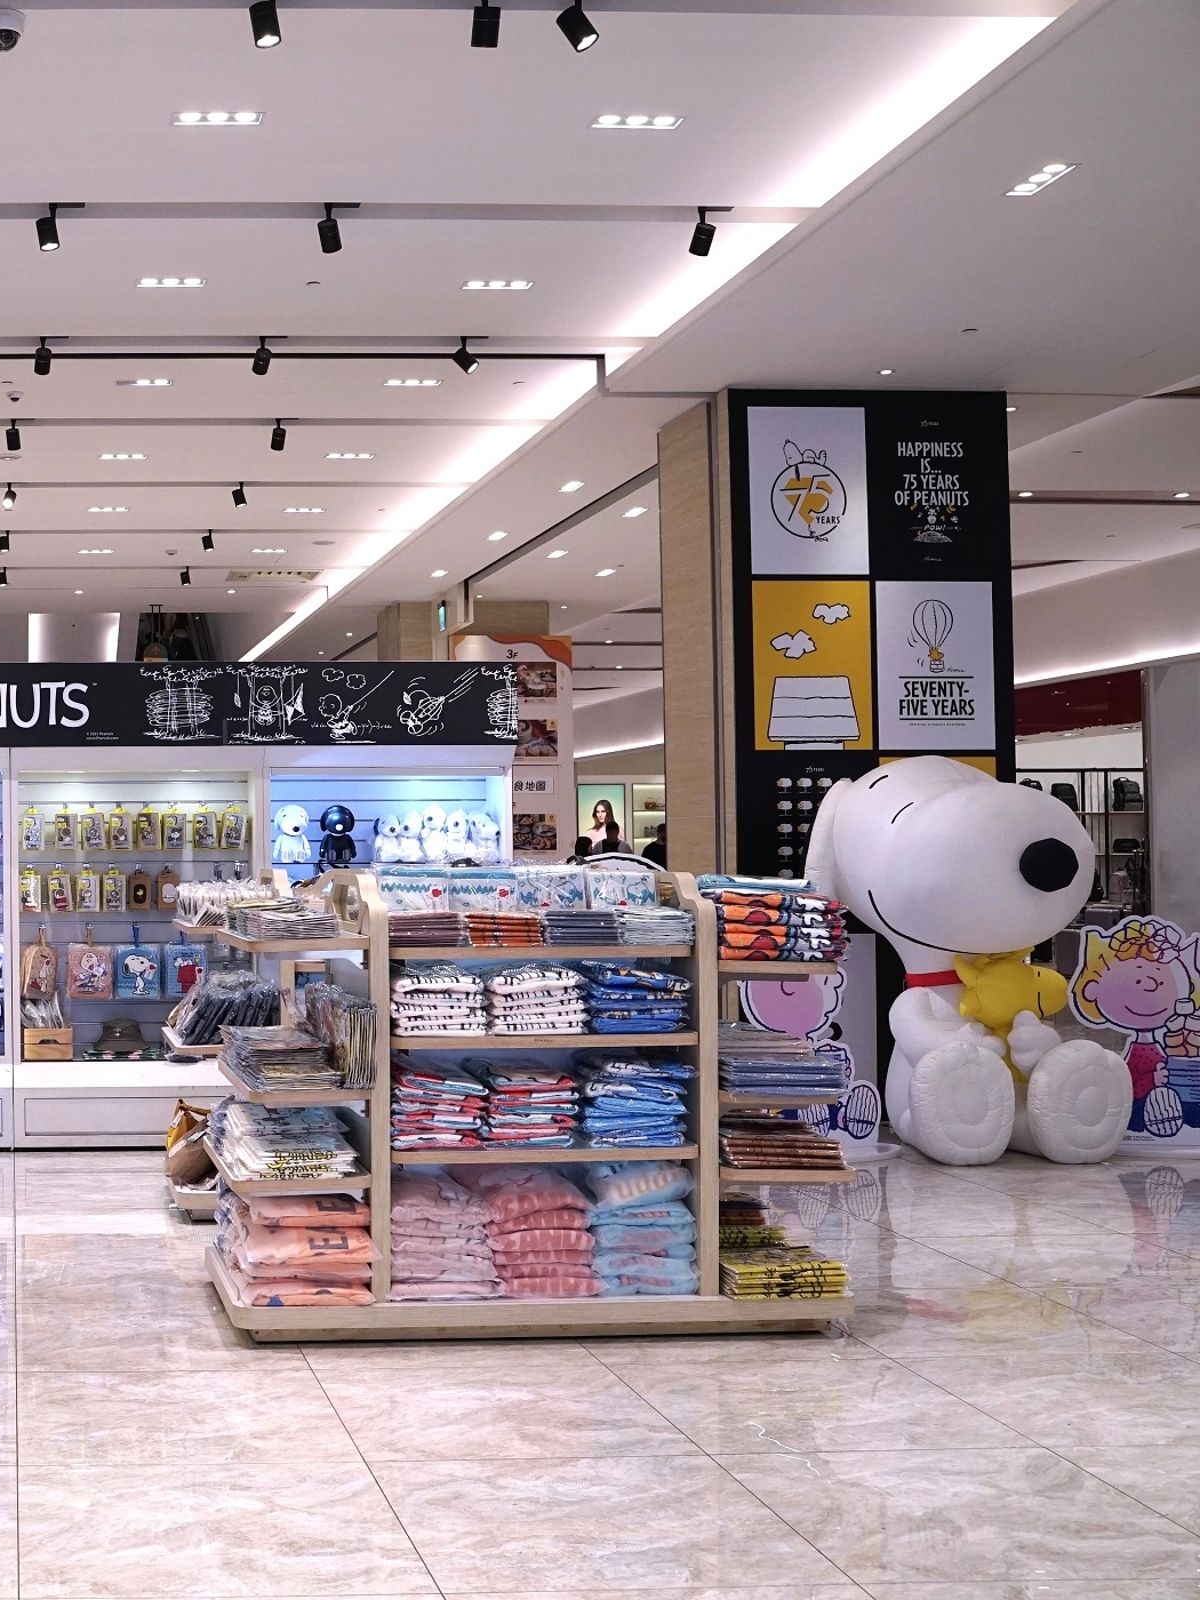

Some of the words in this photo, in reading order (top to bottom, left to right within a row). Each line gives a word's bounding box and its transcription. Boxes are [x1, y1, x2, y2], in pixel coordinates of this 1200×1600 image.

[897, 442, 963, 457] HAPPINESS
[920, 458, 941, 473] IS...
[903, 474, 917, 489] 75
[920, 474, 960, 489] YEARS
[780, 474, 830, 522] 75
[894, 491, 910, 506] OF
[913, 491, 969, 506] PEANUTS
[816, 516, 841, 525] YEARS
[506, 649, 518, 659] 3F
[903, 680, 970, 698] SEVENTY-
[899, 699, 929, 716] FIVE
[931, 699, 975, 716] YEARS
